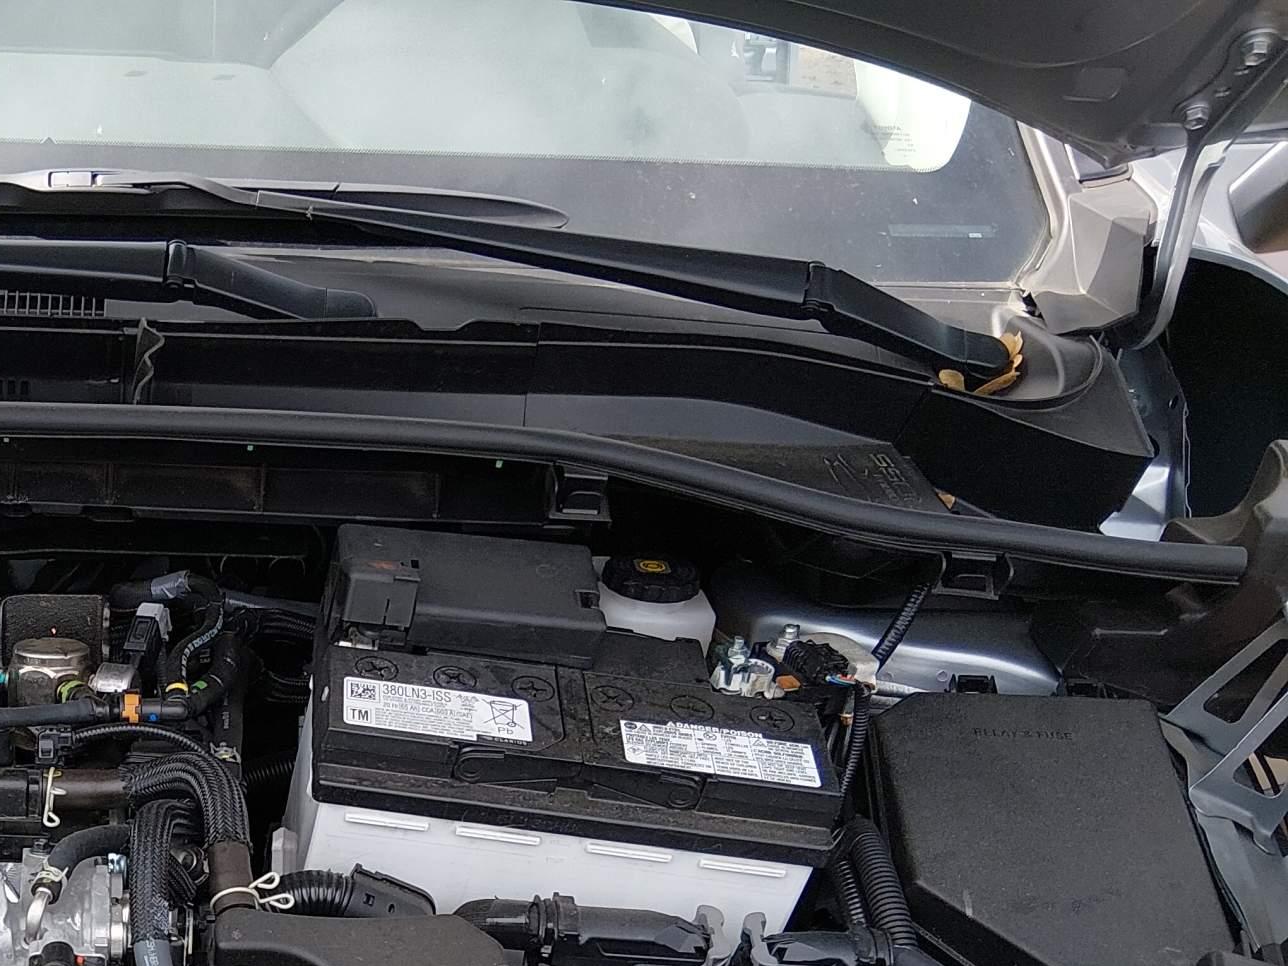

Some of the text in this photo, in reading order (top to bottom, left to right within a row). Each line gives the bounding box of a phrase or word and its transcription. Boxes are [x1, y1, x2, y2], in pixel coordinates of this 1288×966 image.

[382, 684, 452, 703] 380LN3-ISS
[349, 708, 369, 722] TM
[497, 726, 514, 735] Pb
[675, 722, 764, 739] DANGER/POISON
